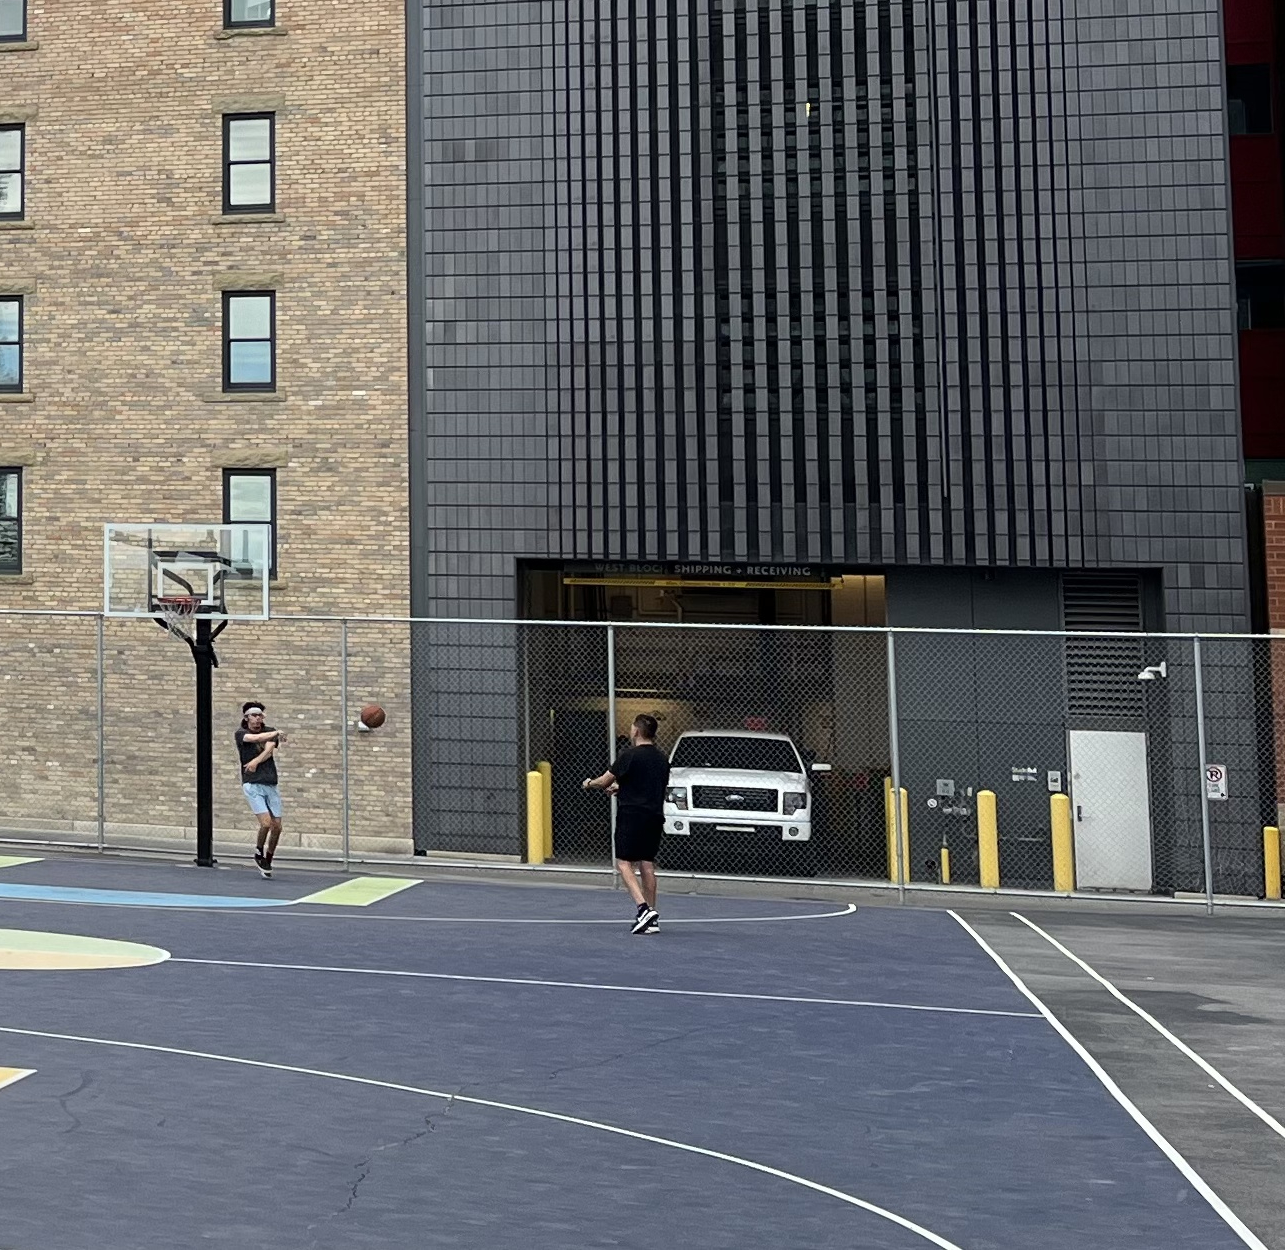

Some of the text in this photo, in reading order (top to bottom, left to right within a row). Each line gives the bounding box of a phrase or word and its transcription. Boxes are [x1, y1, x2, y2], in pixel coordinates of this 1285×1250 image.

[595, 563, 625, 572] WEST
[674, 564, 732, 575] SHIPPING
[746, 566, 811, 576] RECEIVING
